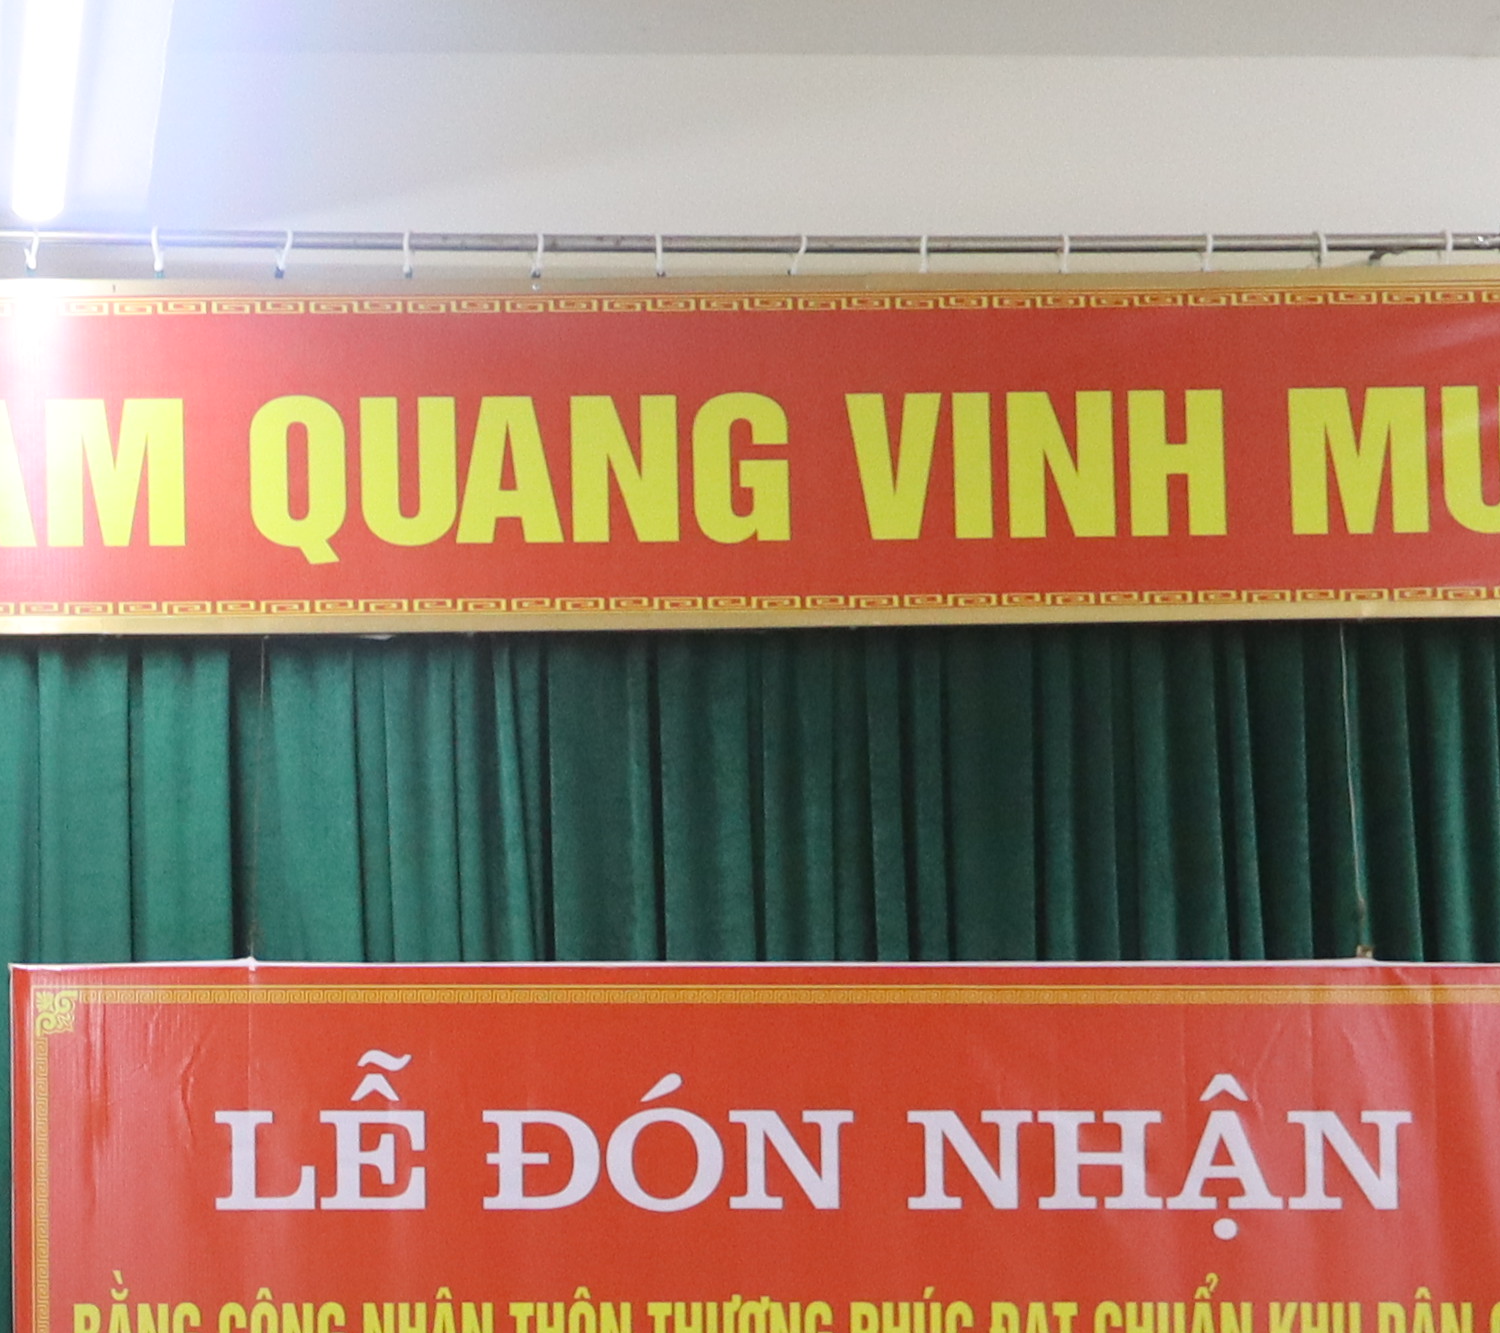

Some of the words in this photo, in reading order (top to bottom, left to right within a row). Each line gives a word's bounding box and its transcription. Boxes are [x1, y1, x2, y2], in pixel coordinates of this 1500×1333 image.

[248, 390, 791, 566] QUANG
[846, 388, 1228, 542] VINH
[214, 1049, 427, 1211] LỄ
[482, 1073, 854, 1212] ĐÓN
[907, 1073, 1413, 1240] NHẬN
